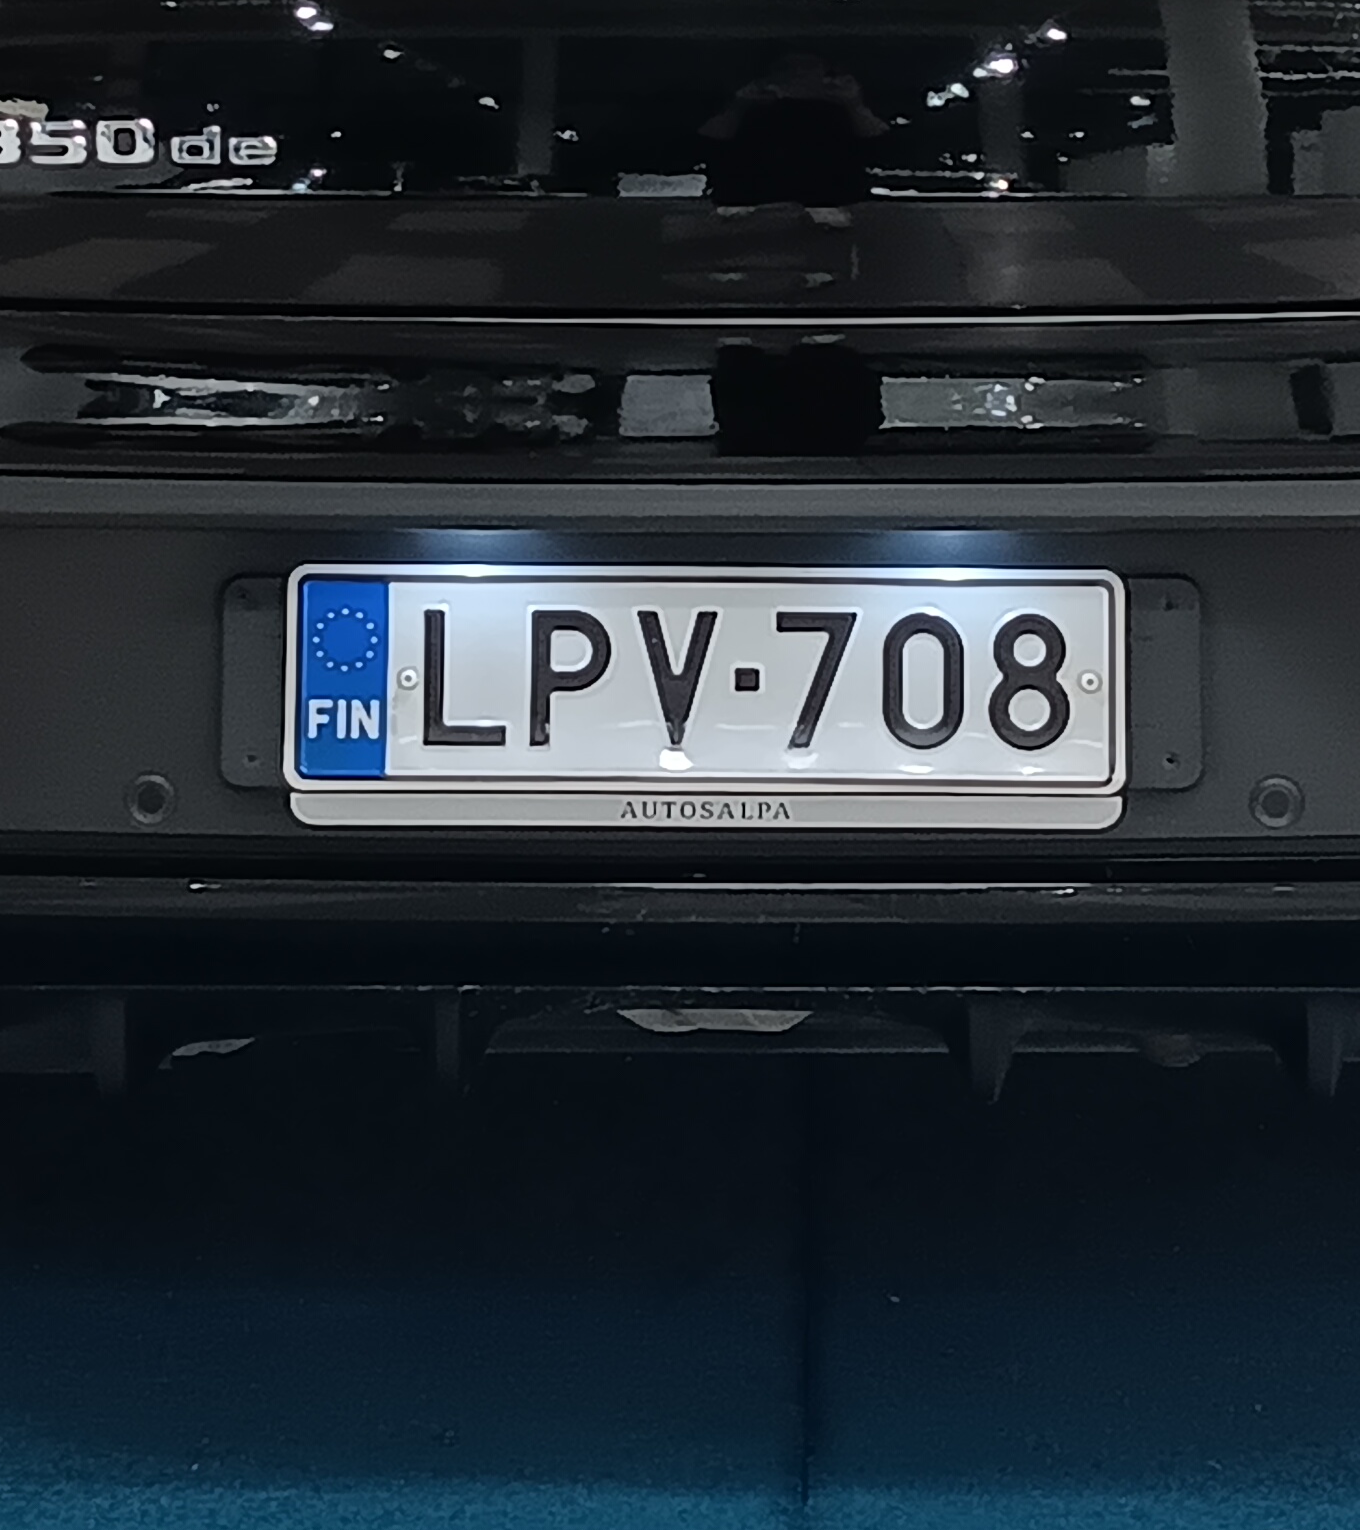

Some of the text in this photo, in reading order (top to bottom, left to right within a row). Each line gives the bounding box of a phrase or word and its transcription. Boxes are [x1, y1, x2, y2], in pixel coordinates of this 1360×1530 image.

[422, 608, 1072, 752] LPV-708
[305, 697, 381, 741] FIN
[620, 800, 791, 820] AUTOSALPA
